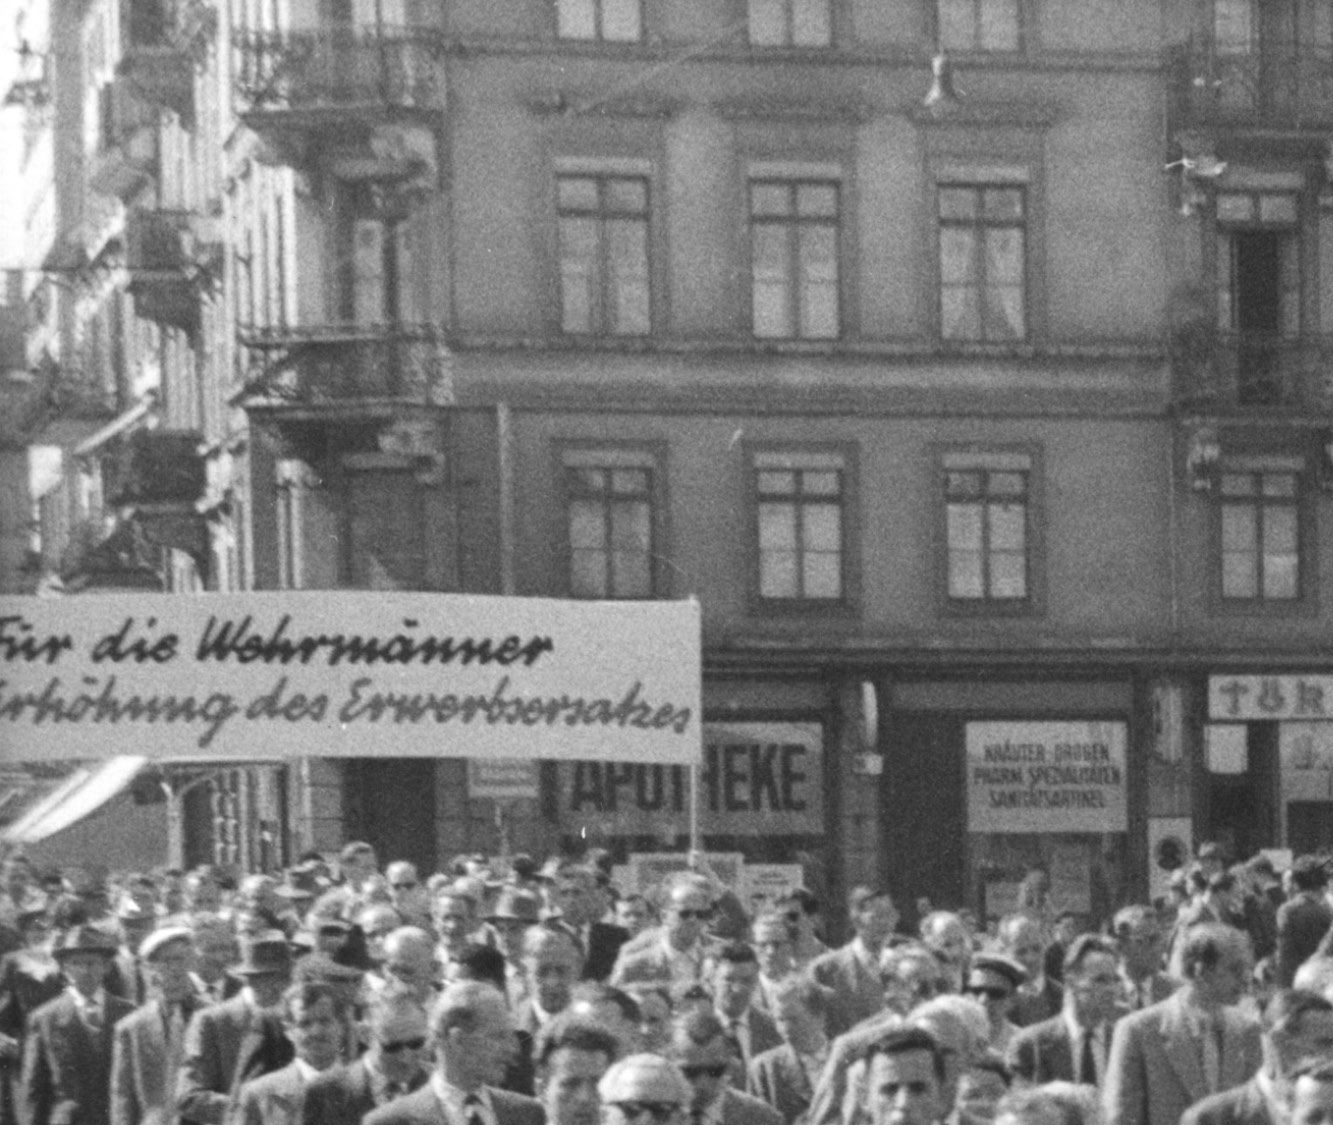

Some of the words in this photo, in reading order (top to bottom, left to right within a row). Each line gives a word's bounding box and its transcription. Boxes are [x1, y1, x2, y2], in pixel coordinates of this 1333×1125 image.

[91, 615, 179, 664] die
[195, 613, 555, 666] Wehrmänner
[0, 673, 240, 748] rhöhung
[244, 674, 328, 722] des
[338, 675, 692, 734] Erwerbsersatzes
